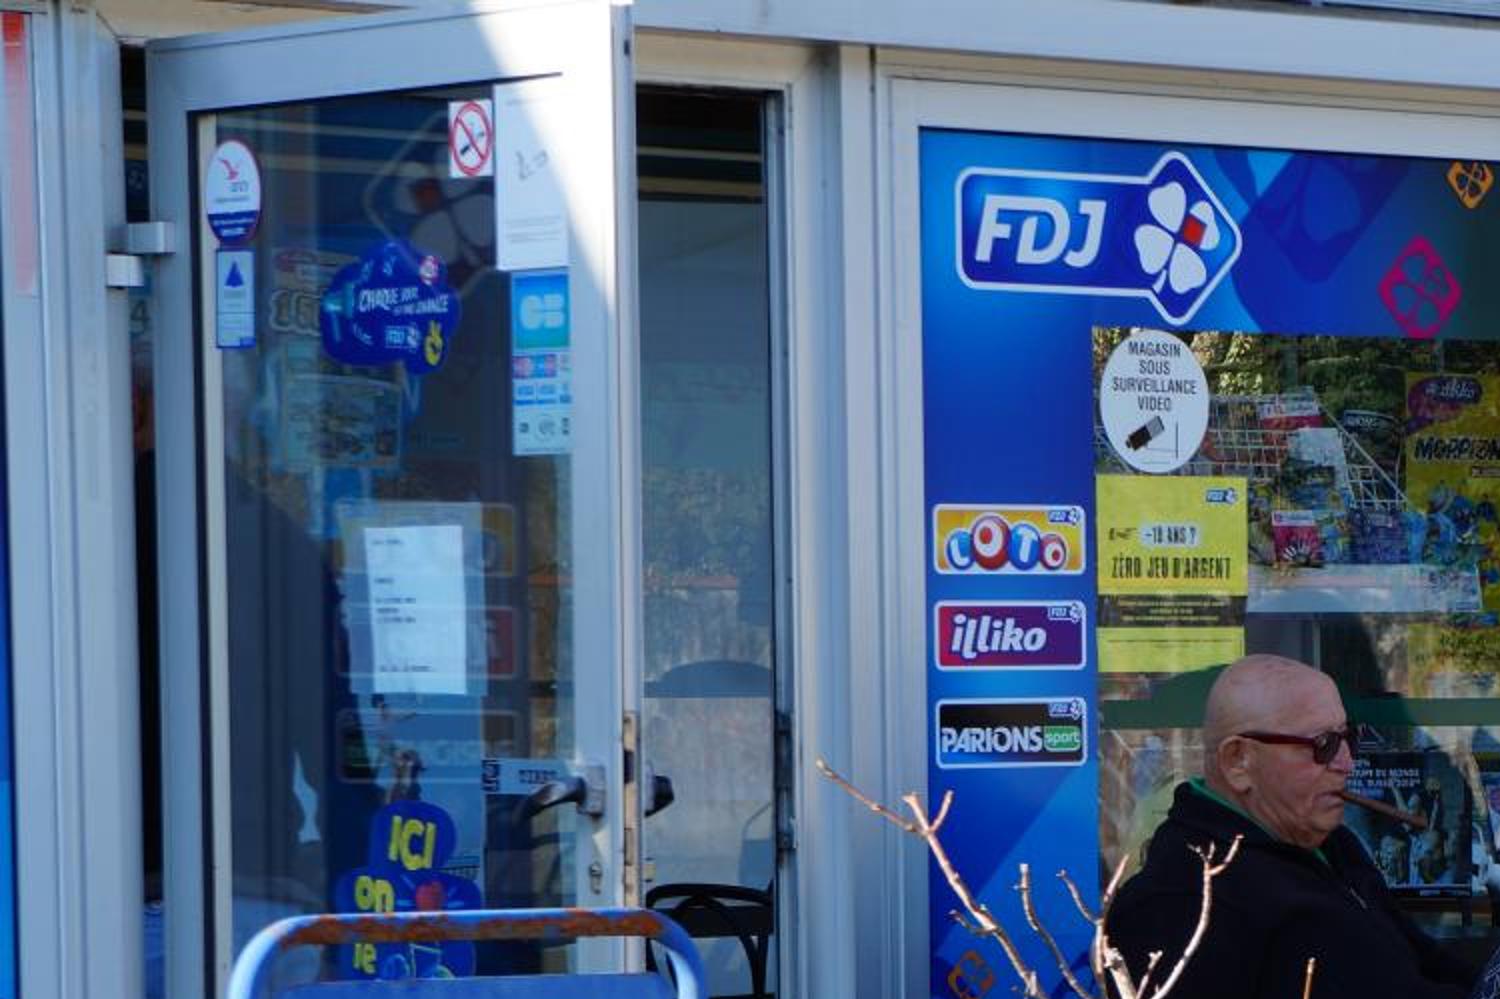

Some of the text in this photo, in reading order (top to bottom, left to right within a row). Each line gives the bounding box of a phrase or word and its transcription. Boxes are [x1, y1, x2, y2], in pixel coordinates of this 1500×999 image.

[975, 194, 1107, 268] FDJ
[1128, 340, 1181, 357] MAGASIN
[1139, 359, 1171, 375] SOUS
[1112, 376, 1197, 395] SURVEILLANCE
[949, 517, 1065, 568] LOTO
[1147, 557, 1169, 579] JEU
[1172, 557, 1231, 579] D'ARGENT
[951, 613, 1047, 660] illiko
[941, 726, 1080, 753] PARIONS sport
[388, 815, 437, 871] ICI
[354, 875, 395, 913] on
